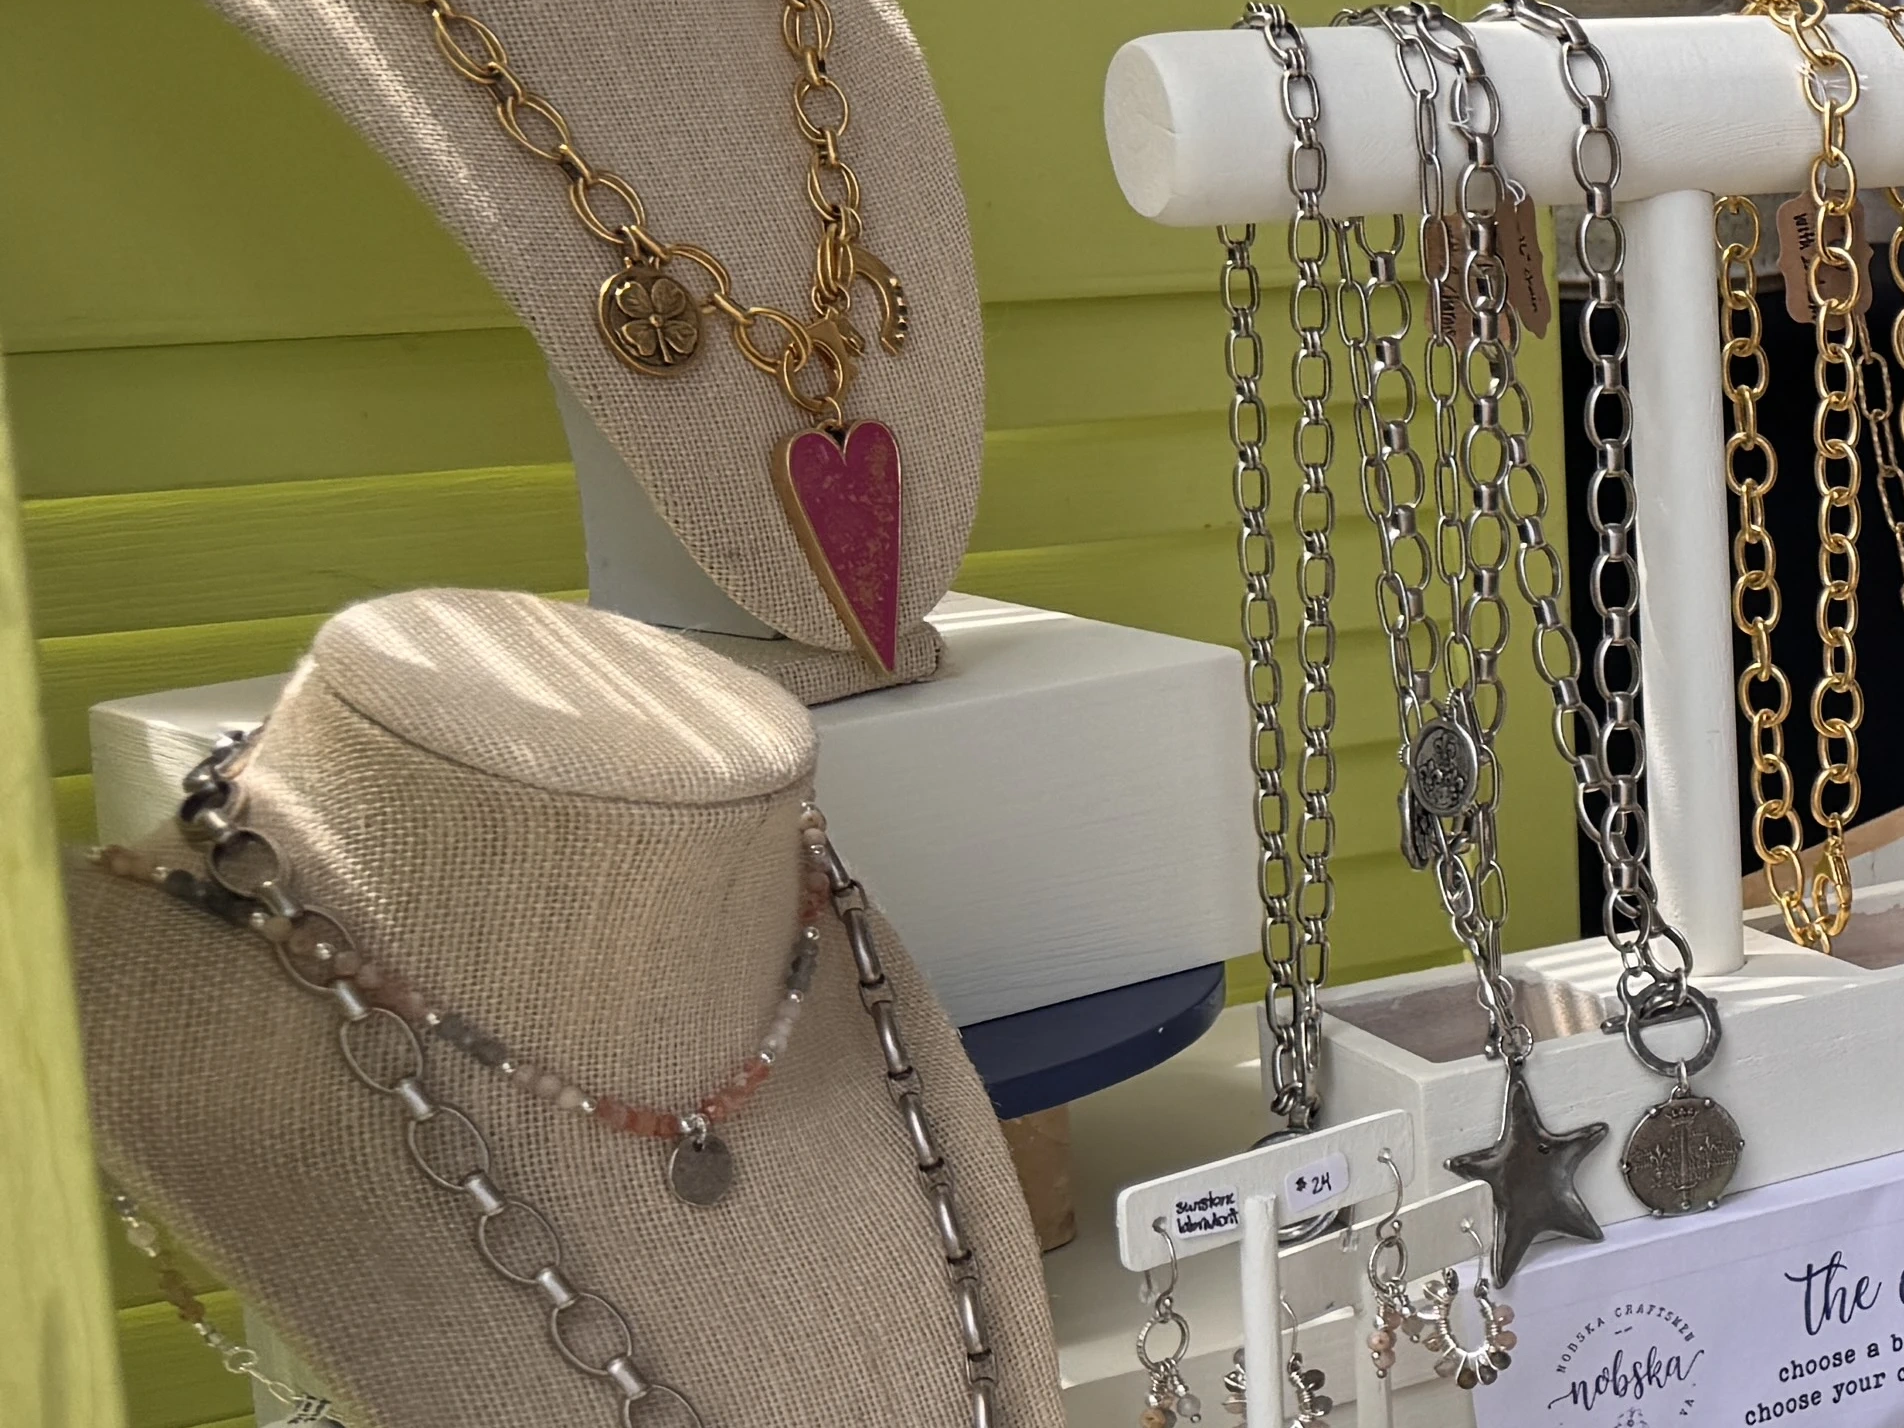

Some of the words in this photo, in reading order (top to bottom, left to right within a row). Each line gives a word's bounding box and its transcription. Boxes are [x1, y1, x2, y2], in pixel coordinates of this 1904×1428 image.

[1785, 1250, 1881, 1336] the
[1547, 1345, 1704, 1411] nobska
[1778, 1348, 1856, 1384] choose
[1867, 1342, 1880, 1358] a
[1744, 1390, 1822, 1427] choose
[1831, 1372, 1886, 1404] your
